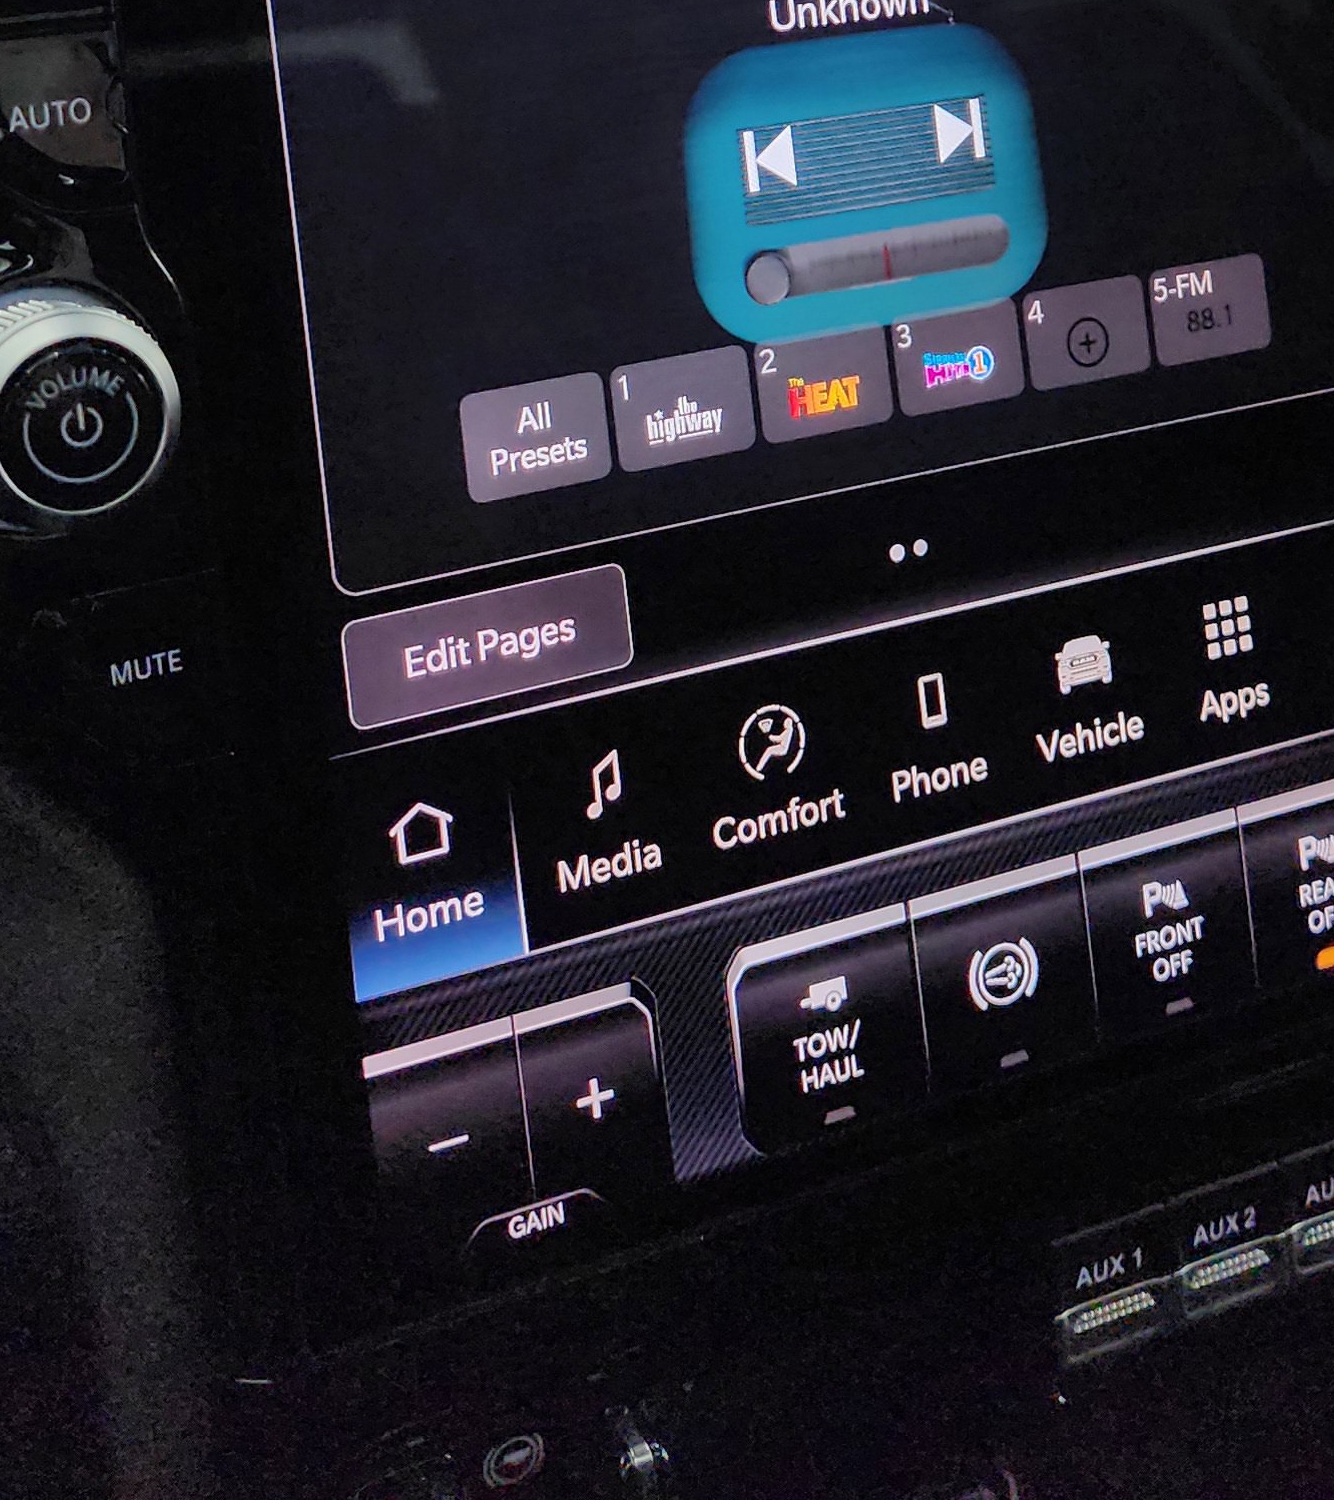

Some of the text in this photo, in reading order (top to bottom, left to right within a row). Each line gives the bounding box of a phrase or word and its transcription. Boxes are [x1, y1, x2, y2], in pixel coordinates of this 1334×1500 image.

[9, 98, 91, 132] AUTO
[1153, 269, 1213, 303] 5-FM
[1027, 300, 1044, 325] 4
[1188, 304, 1232, 332] 88.1
[896, 324, 912, 348] 3
[759, 349, 777, 374] 2
[27, 366, 126, 410] VOLUME
[617, 374, 630, 401] 1
[678, 396, 697, 415] the
[788, 374, 860, 419] HEAT
[518, 401, 552, 434] All
[647, 406, 723, 445] highway
[491, 437, 588, 476] Presets
[405, 617, 576, 679] Edit Pages
[110, 649, 183, 687] MUTE
[1200, 682, 1270, 724] Apps
[1036, 712, 1144, 763] Vehicle
[892, 755, 988, 802] Phone
[713, 789, 846, 850] Comfort
[557, 840, 662, 893] Media
[373, 890, 484, 943] Home
[1135, 915, 1204, 958] FRONT
[1153, 951, 1194, 982] OFF
[793, 1018, 861, 1062] TOW/
[800, 1055, 865, 1095] HAUL
[508, 1202, 564, 1239] GAIN
[1193, 1206, 1256, 1247] AUX 2
[1076, 1247, 1143, 1290] AUX 1
